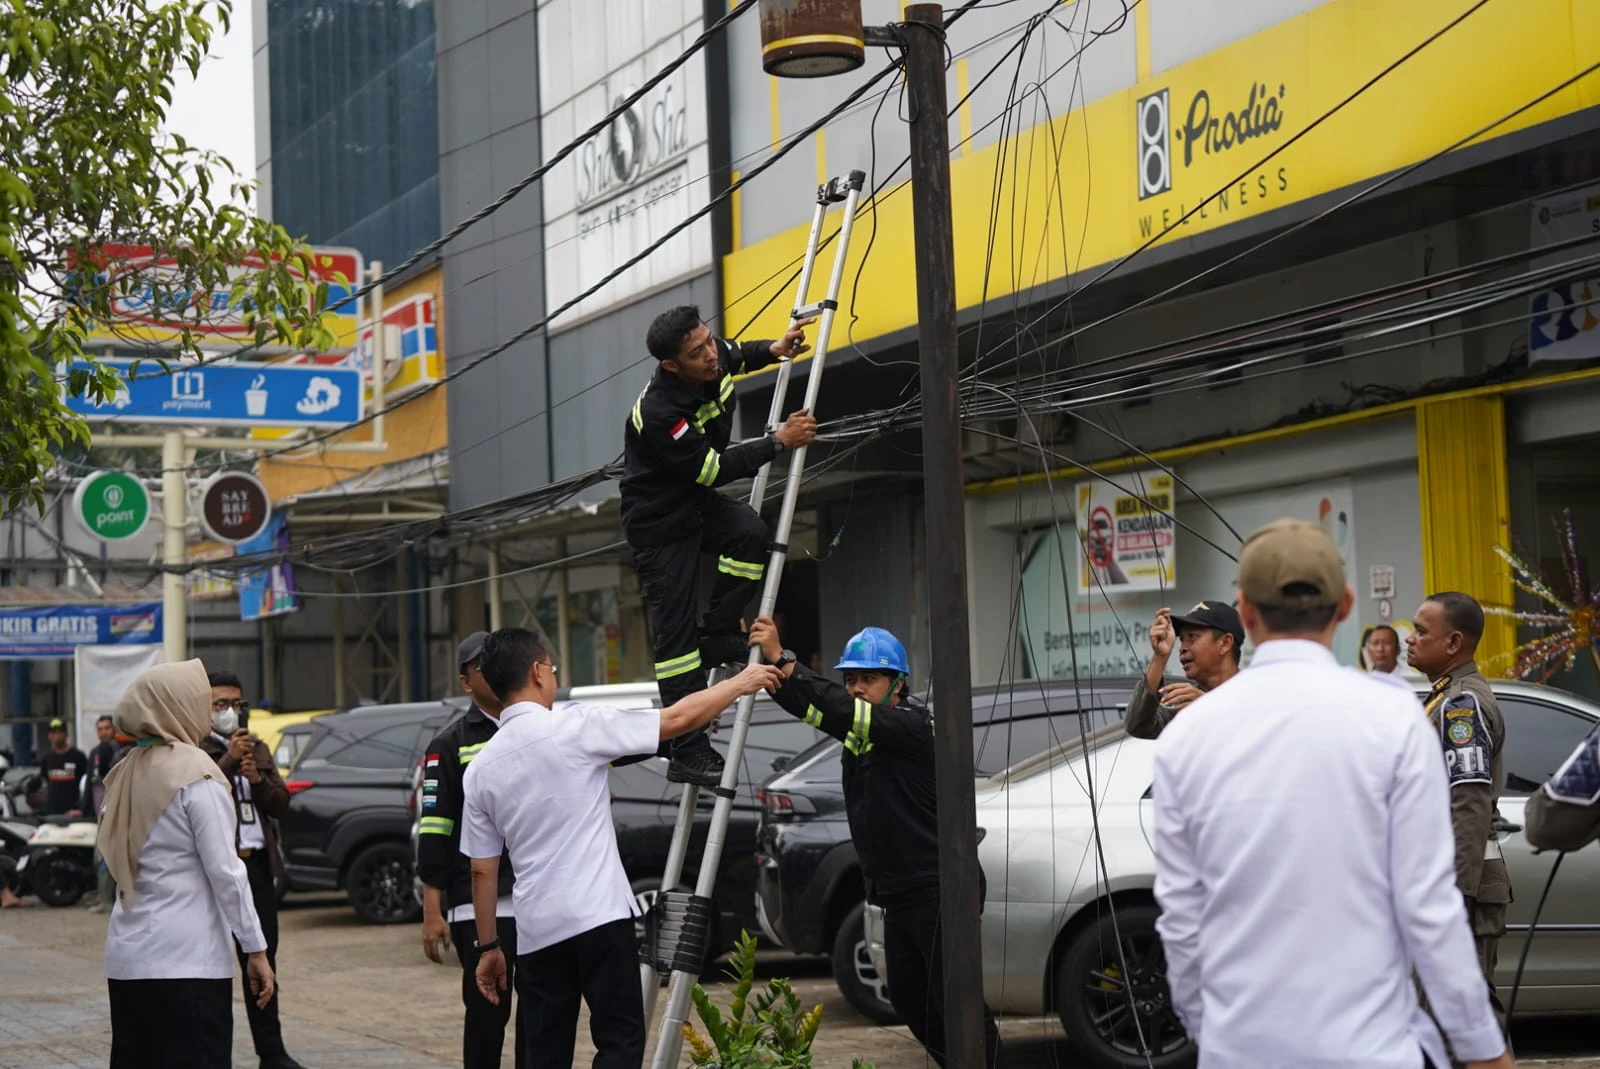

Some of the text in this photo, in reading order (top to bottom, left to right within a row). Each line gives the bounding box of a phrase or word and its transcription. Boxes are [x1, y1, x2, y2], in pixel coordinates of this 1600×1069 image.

[1176, 81, 1285, 168] Prodia
[1139, 167, 1287, 238] WELLNESS
[162, 399, 211, 411] payment
[221, 491, 249, 501] SAY
[222, 503, 249, 514] BRE
[97, 510, 134, 528] point
[0, 617, 32, 633] KIR
[36, 616, 98, 633] GRATIS
[1445, 747, 1486, 777] PTI
